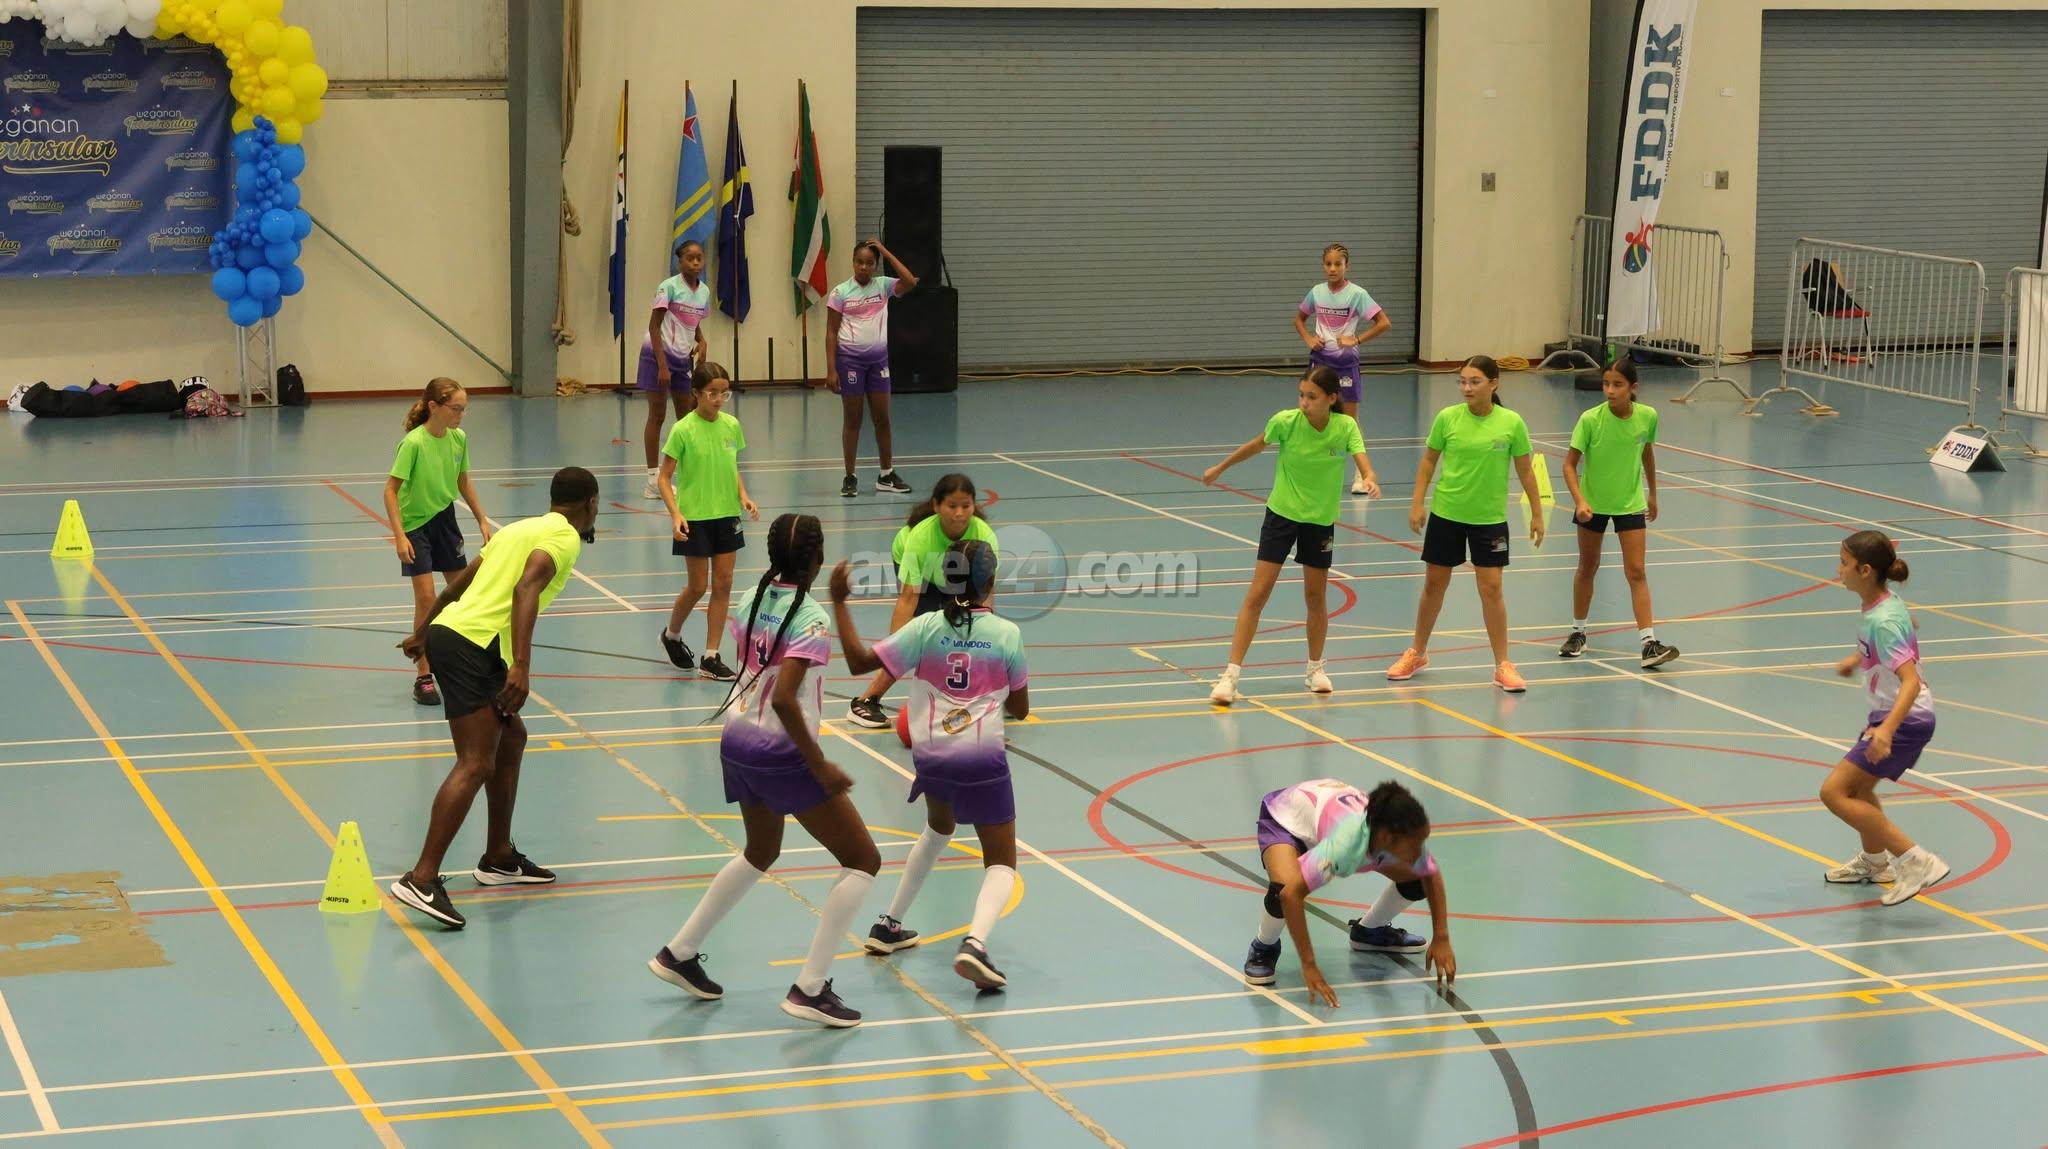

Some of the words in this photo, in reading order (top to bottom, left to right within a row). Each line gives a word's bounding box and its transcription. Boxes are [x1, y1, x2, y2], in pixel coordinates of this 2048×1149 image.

[136, 110, 182, 119] weganan
[1630, 23, 1682, 201] FDDK
[60, 229, 106, 238] weganan
[160, 226, 208, 236] weganan
[1950, 443, 1979, 460] FDDK
[953, 640, 992, 649] VANDDIS
[945, 652, 971, 690] 3
